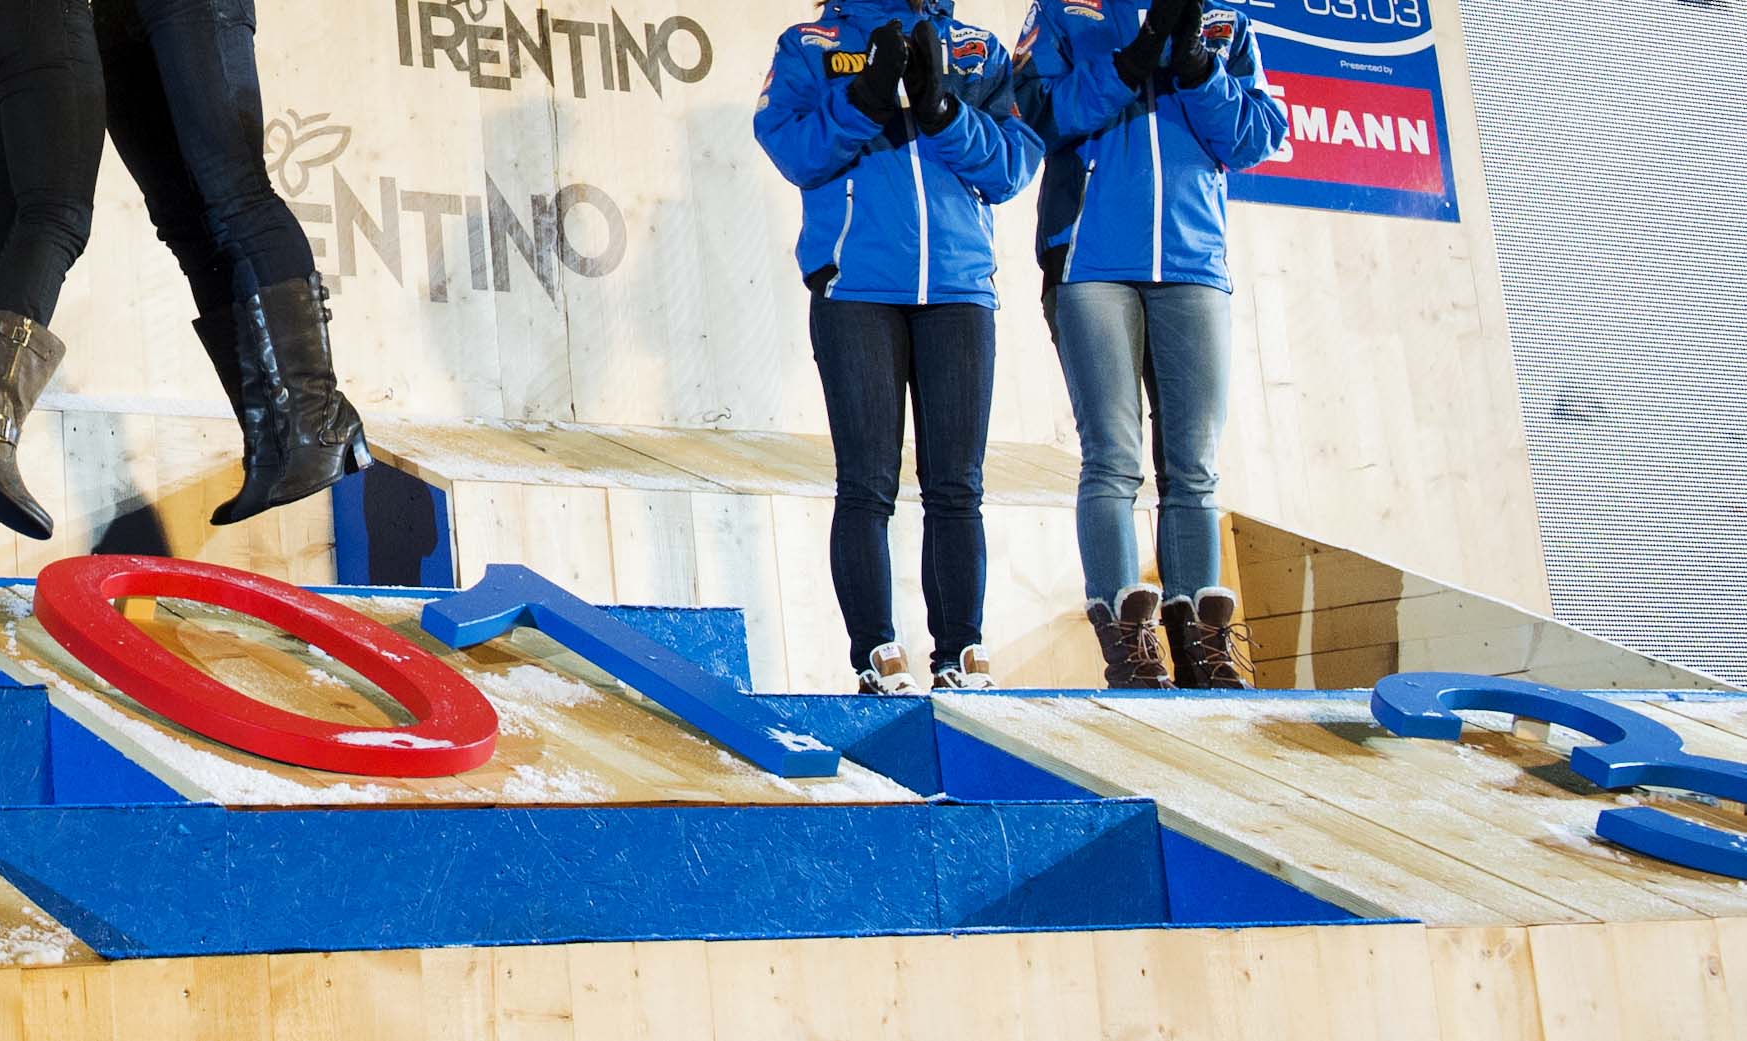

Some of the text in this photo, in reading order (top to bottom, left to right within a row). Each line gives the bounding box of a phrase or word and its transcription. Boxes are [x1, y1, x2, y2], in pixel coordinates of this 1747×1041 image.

[1339, 59, 1394, 76] Presented by
[287, 165, 628, 312] ENTINO
